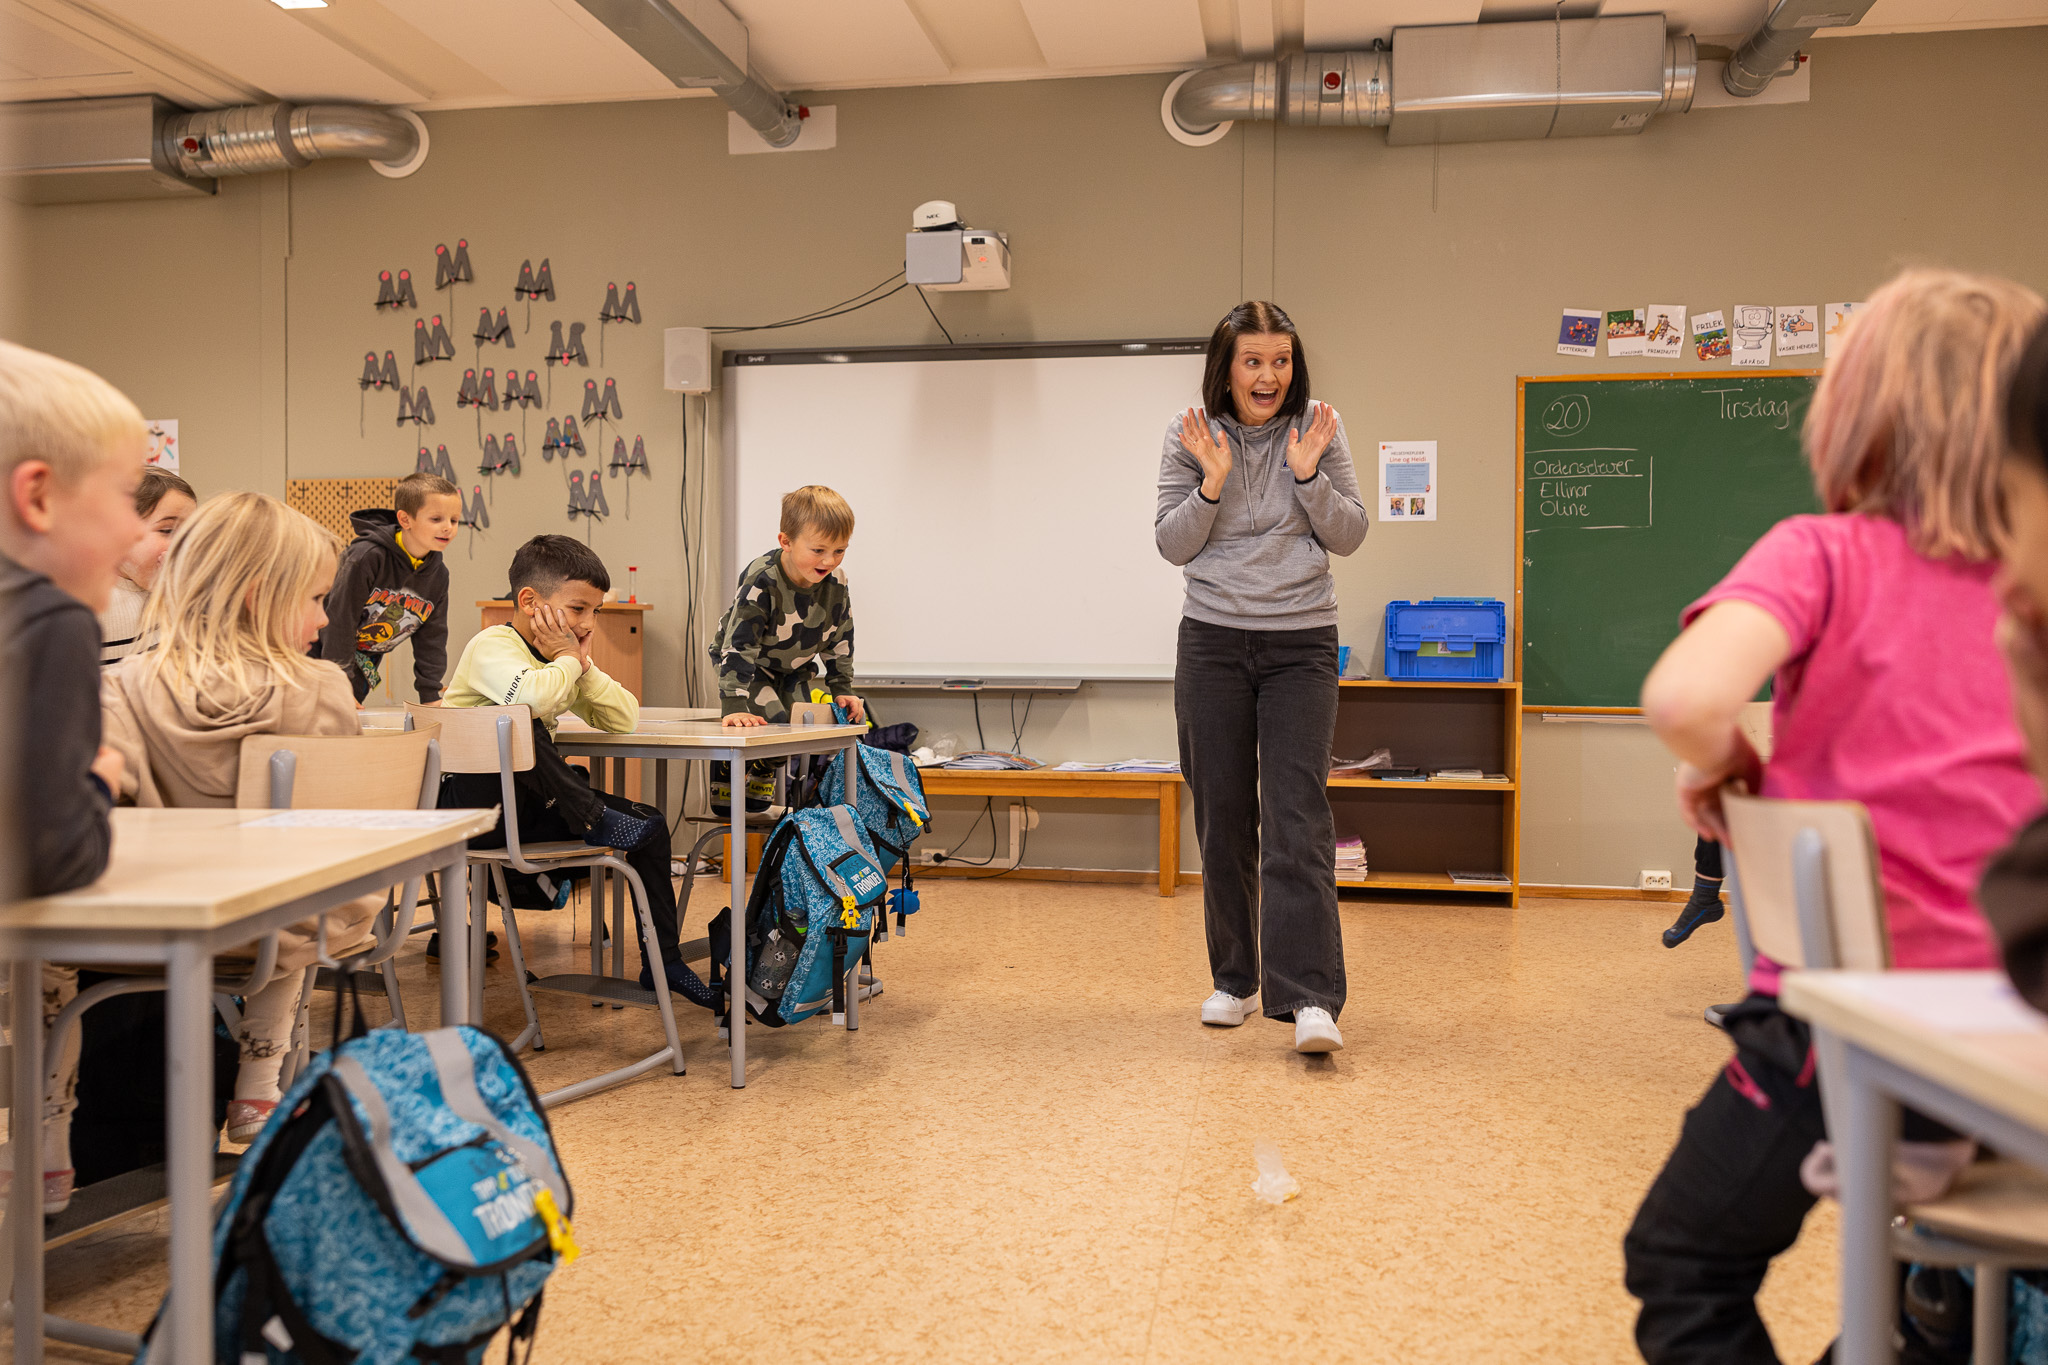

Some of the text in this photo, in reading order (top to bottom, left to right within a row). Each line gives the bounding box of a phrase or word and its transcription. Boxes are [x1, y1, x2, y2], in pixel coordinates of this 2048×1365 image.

[1696, 320, 1723, 331] FRILEK
[1546, 401, 1582, 430] 20
[1701, 388, 1790, 429] Tirsdag
[1539, 481, 1592, 499] Ellinor
[1539, 501, 1591, 517] Oline
